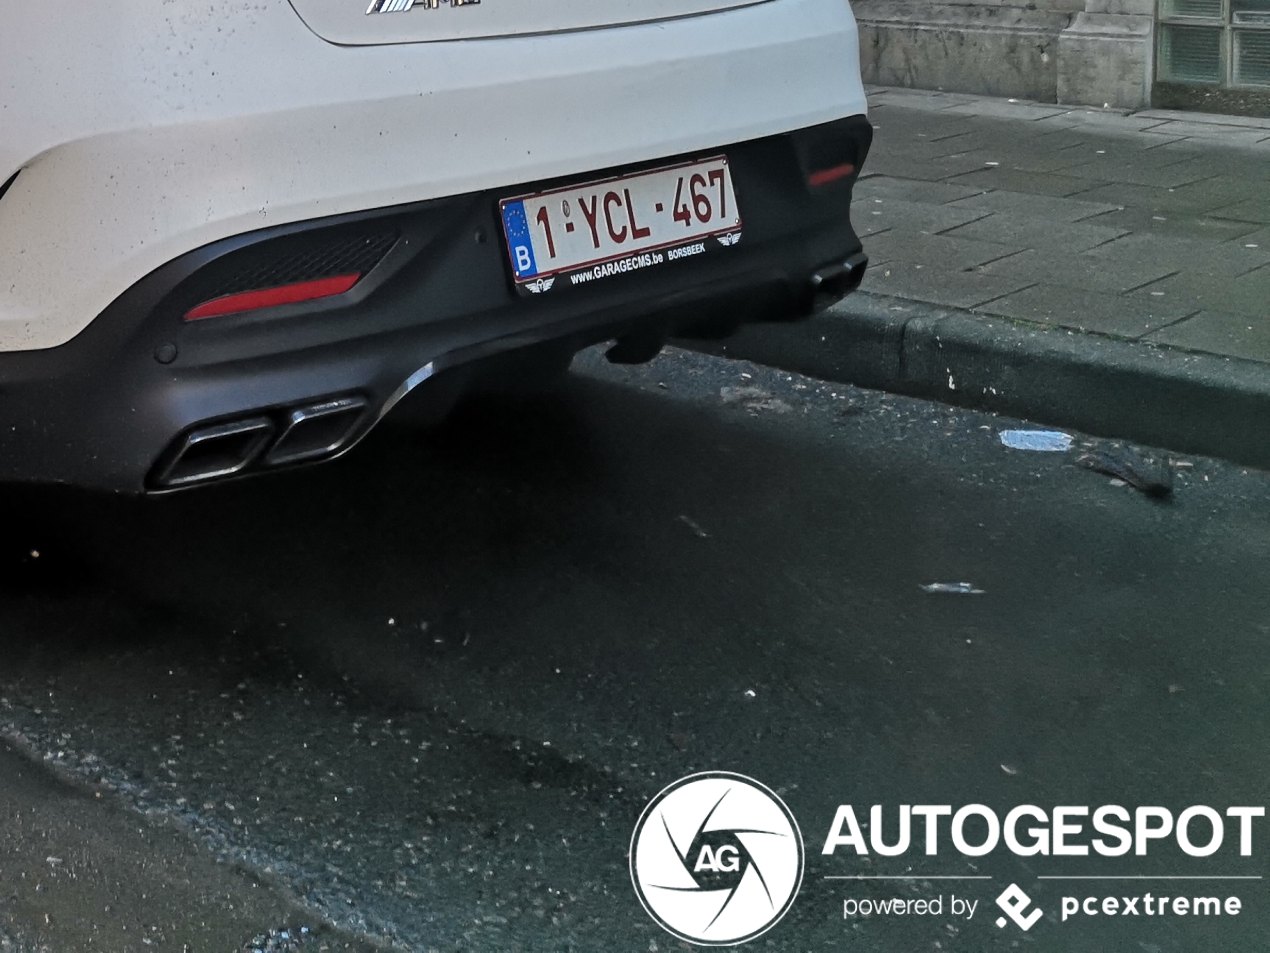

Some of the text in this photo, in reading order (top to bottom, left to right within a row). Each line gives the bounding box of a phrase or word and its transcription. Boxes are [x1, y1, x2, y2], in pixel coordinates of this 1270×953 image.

[514, 245, 532, 273] B
[570, 242, 707, 285] www.GARAGECMS.be BORSBEEK
